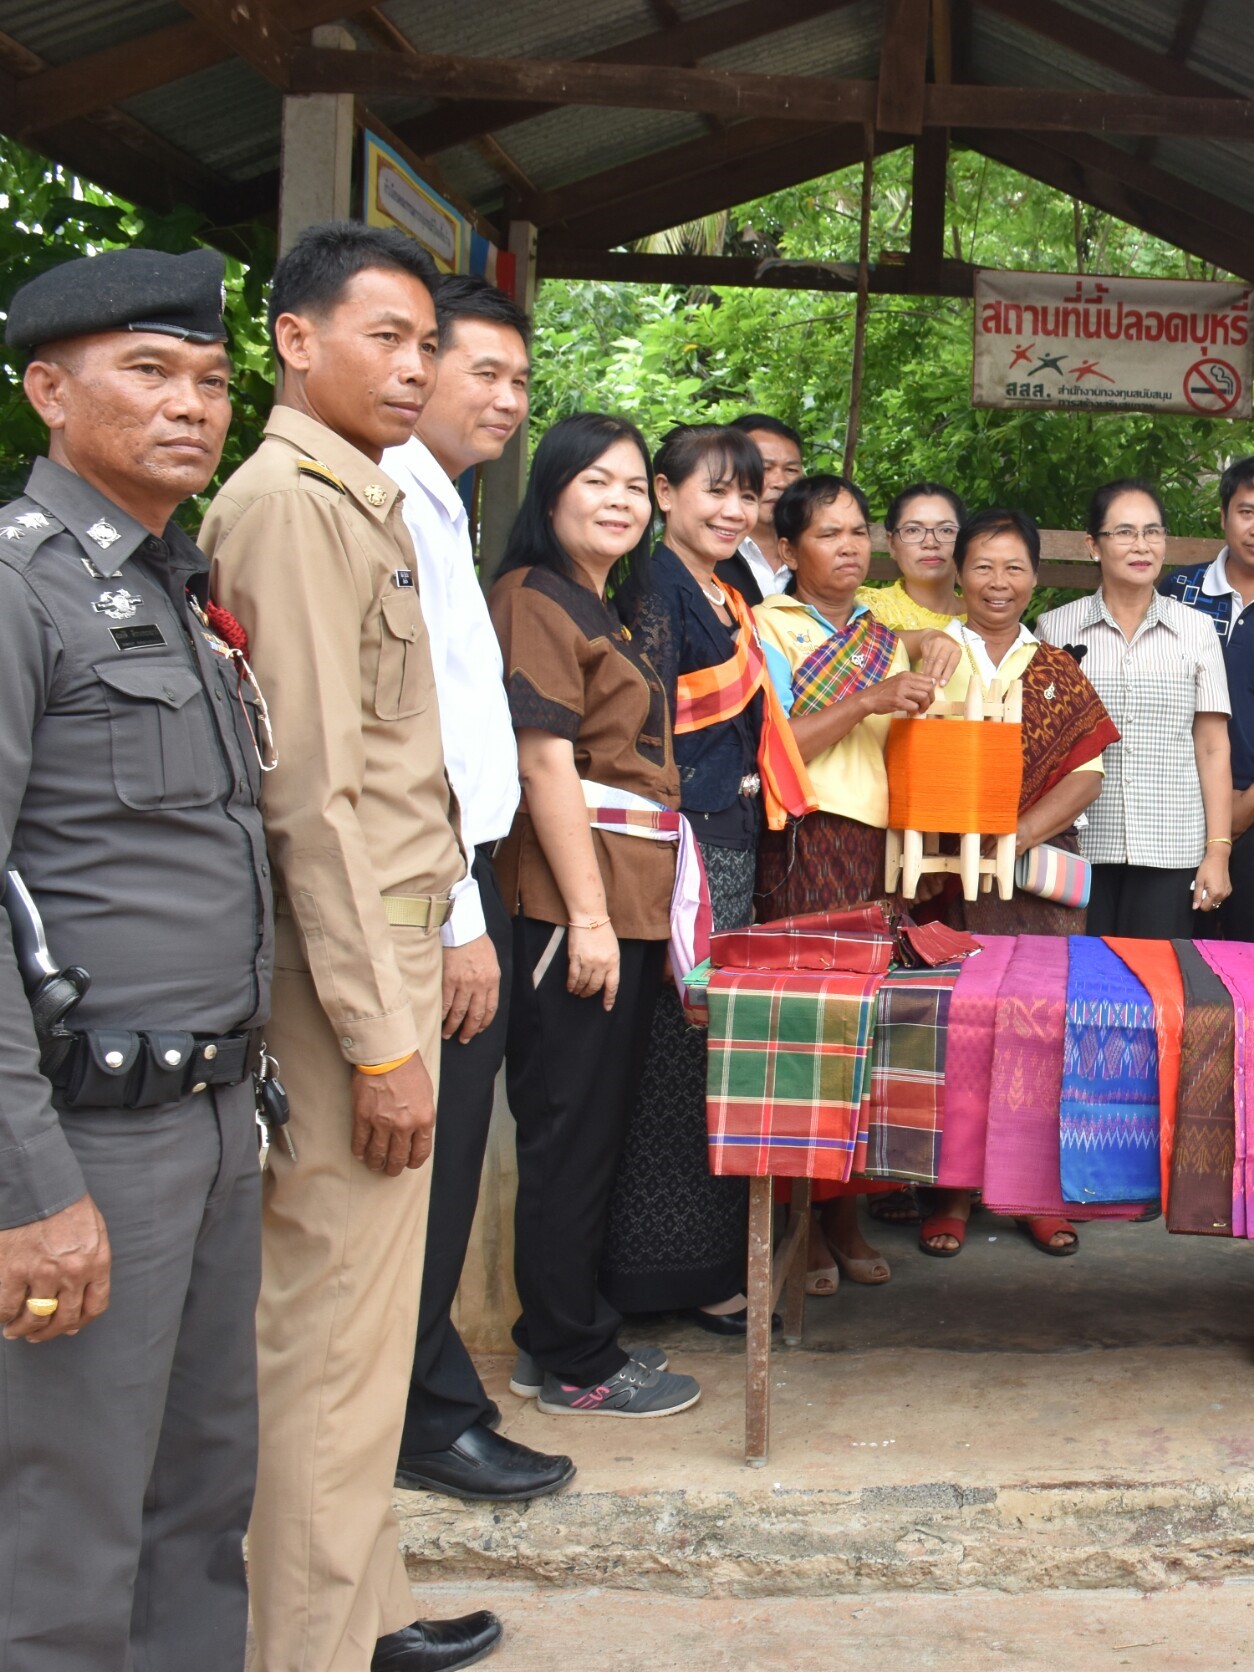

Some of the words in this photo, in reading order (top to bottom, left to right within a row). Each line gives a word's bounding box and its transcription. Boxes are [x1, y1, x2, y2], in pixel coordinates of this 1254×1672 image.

[982, 281, 1249, 356] สถานที่นี้ปลอดบุหรี่
[1006, 382, 1051, 398] สสส.
